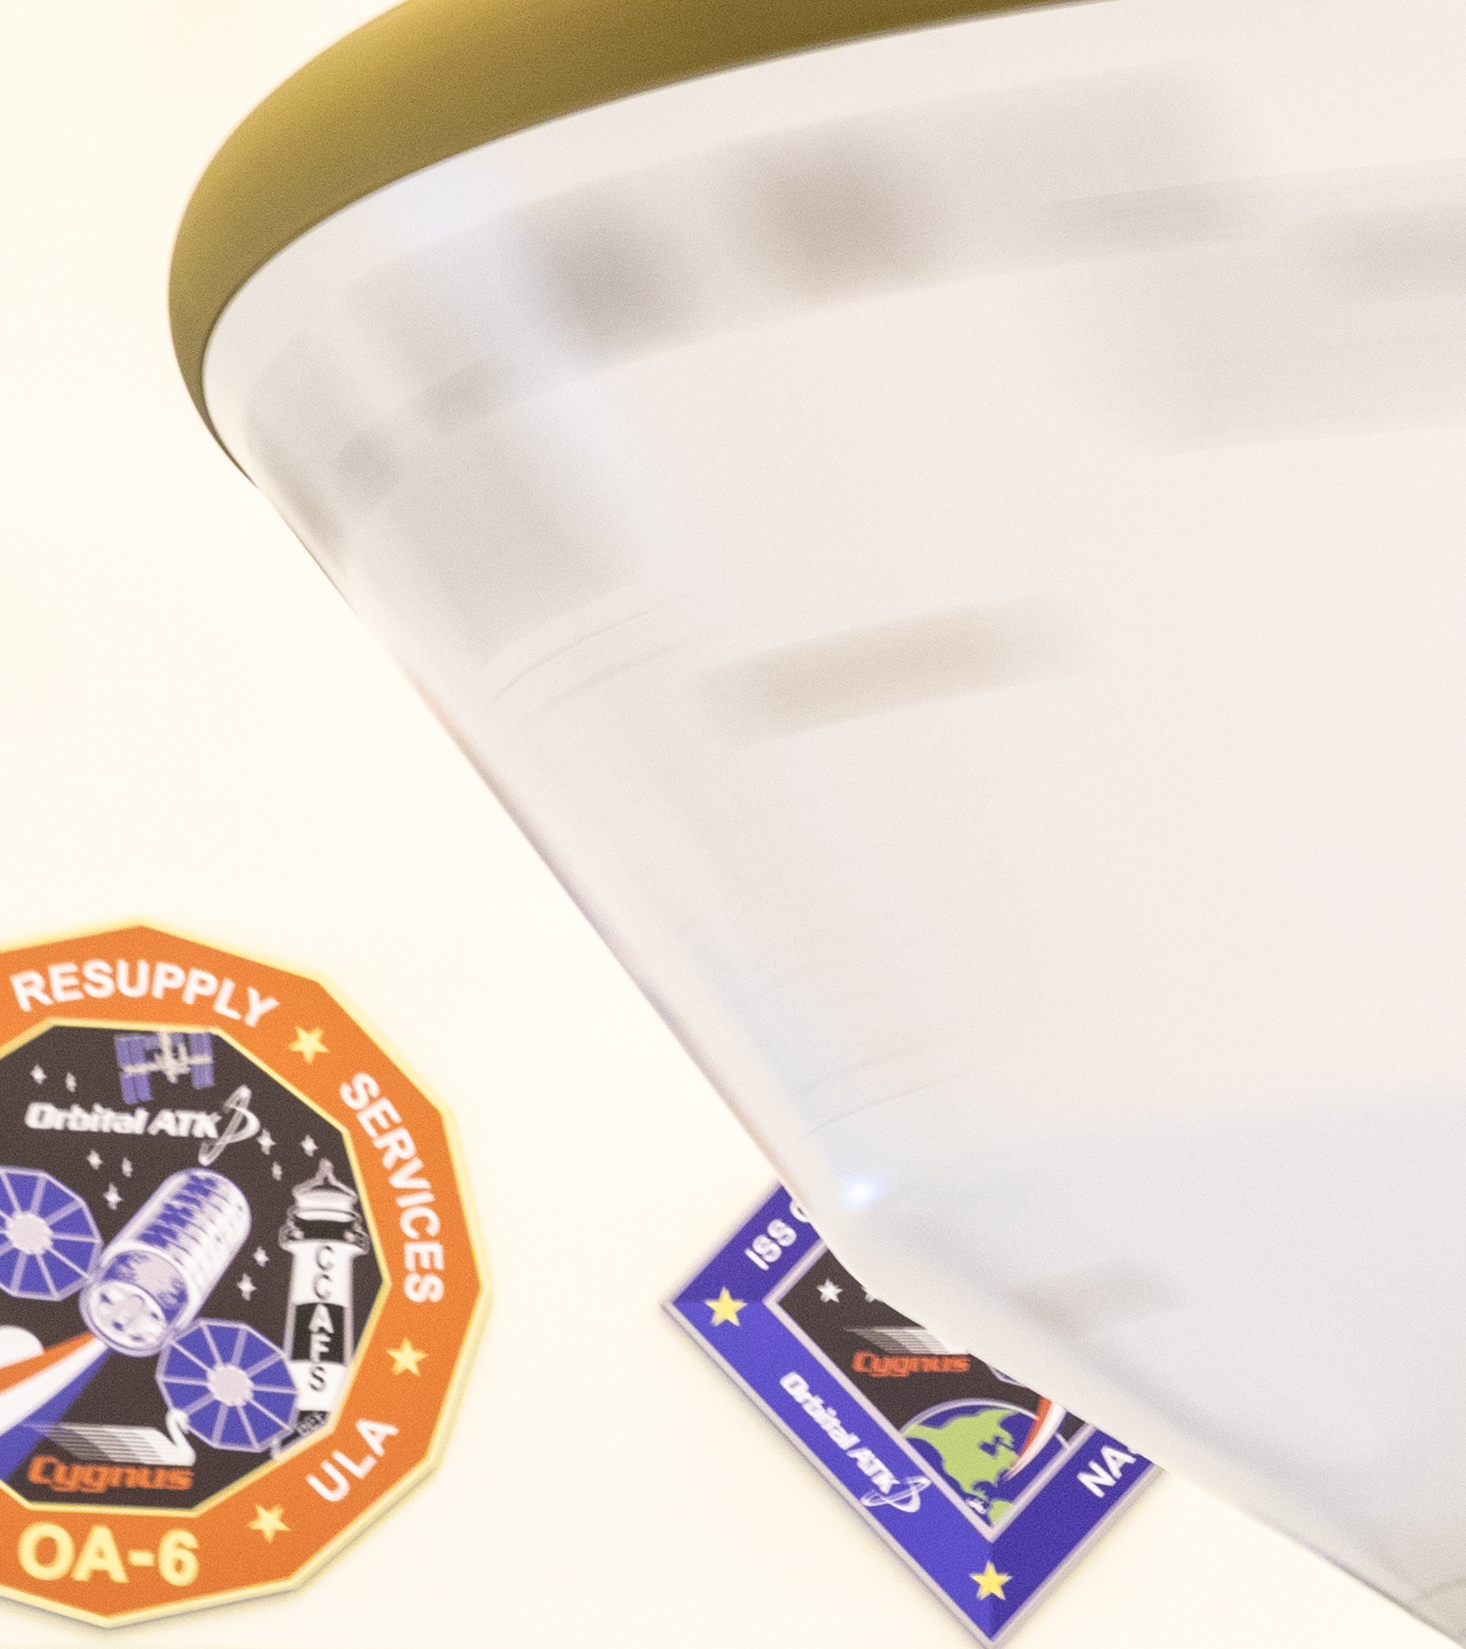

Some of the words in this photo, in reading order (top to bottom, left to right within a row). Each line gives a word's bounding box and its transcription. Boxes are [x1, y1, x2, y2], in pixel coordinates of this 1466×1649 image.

[10, 959, 280, 1028] RESUPPLY
[24, 1102, 149, 1135] Orbital
[148, 1109, 222, 1139] ATK
[339, 1072, 446, 1303] SERVICES
[744, 1218, 798, 1272] ISS
[852, 1350, 970, 1378] Cygnus
[305, 1418, 399, 1502] ULA
[779, 1370, 861, 1452] Orbital
[845, 1447, 901, 1495] ATK
[27, 1455, 193, 1493] Cygnus
[17, 1522, 200, 1587] OA-6
